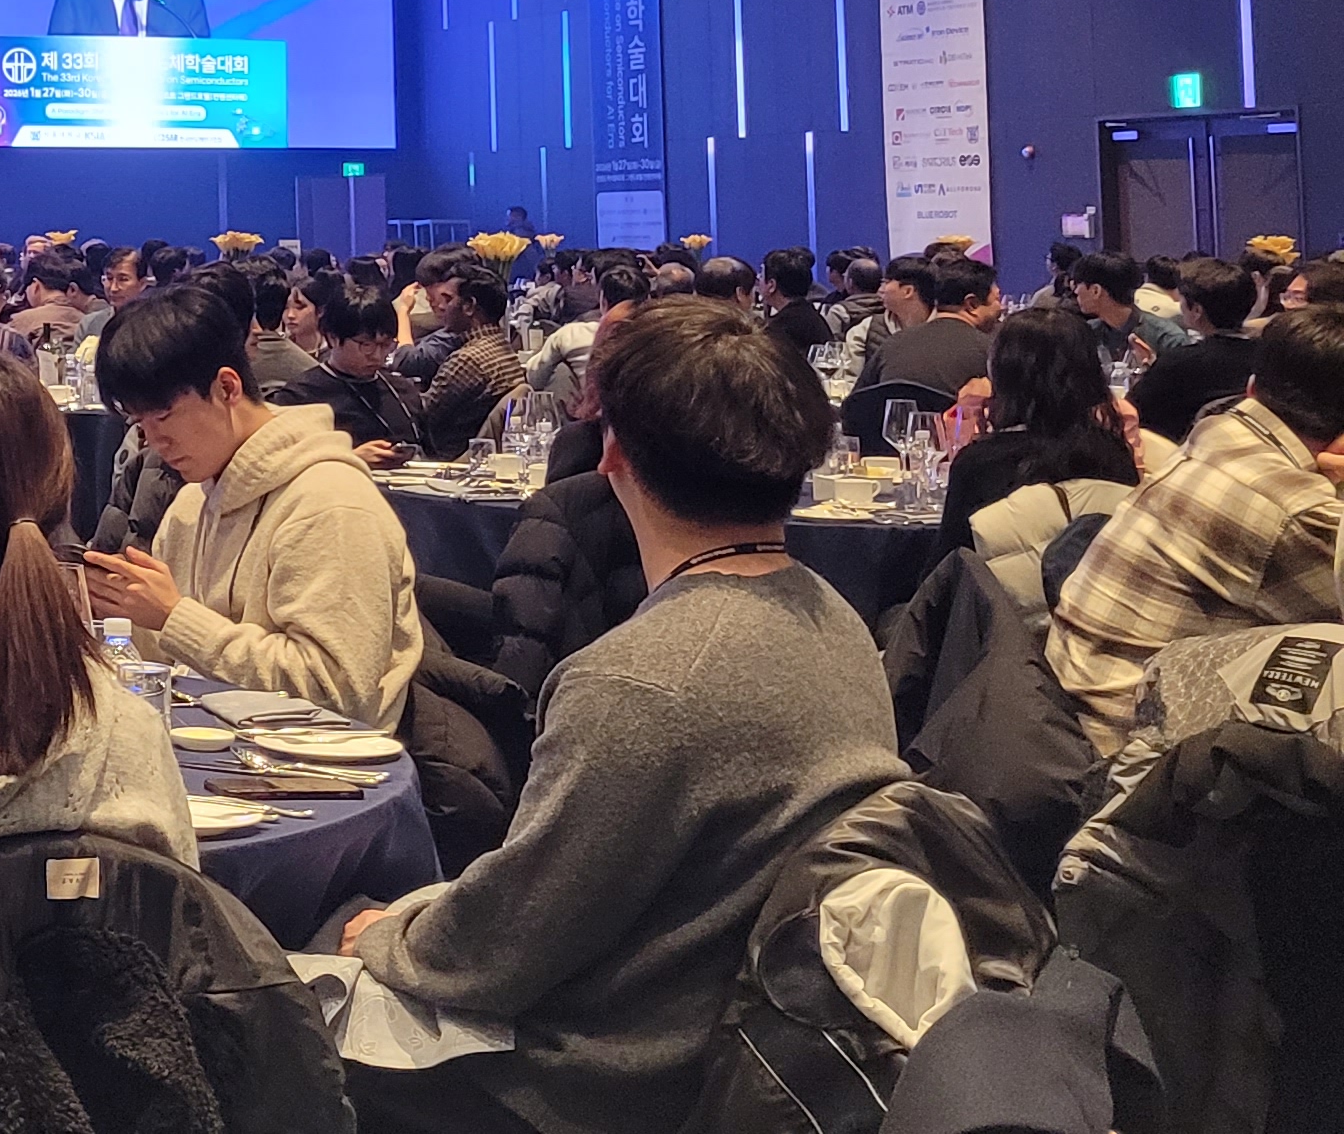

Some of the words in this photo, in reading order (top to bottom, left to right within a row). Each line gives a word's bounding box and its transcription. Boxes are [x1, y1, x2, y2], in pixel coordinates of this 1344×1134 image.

[897, 4, 914, 15] ATM
[614, 13, 623, 32] on
[41, 50, 58, 71] 제
[61, 50, 99, 71] 33회
[41, 72, 59, 82] The
[59, 73, 81, 83] 33rd
[179, 75, 249, 86] Semiconductors
[615, 34, 627, 148] Semiconductors
